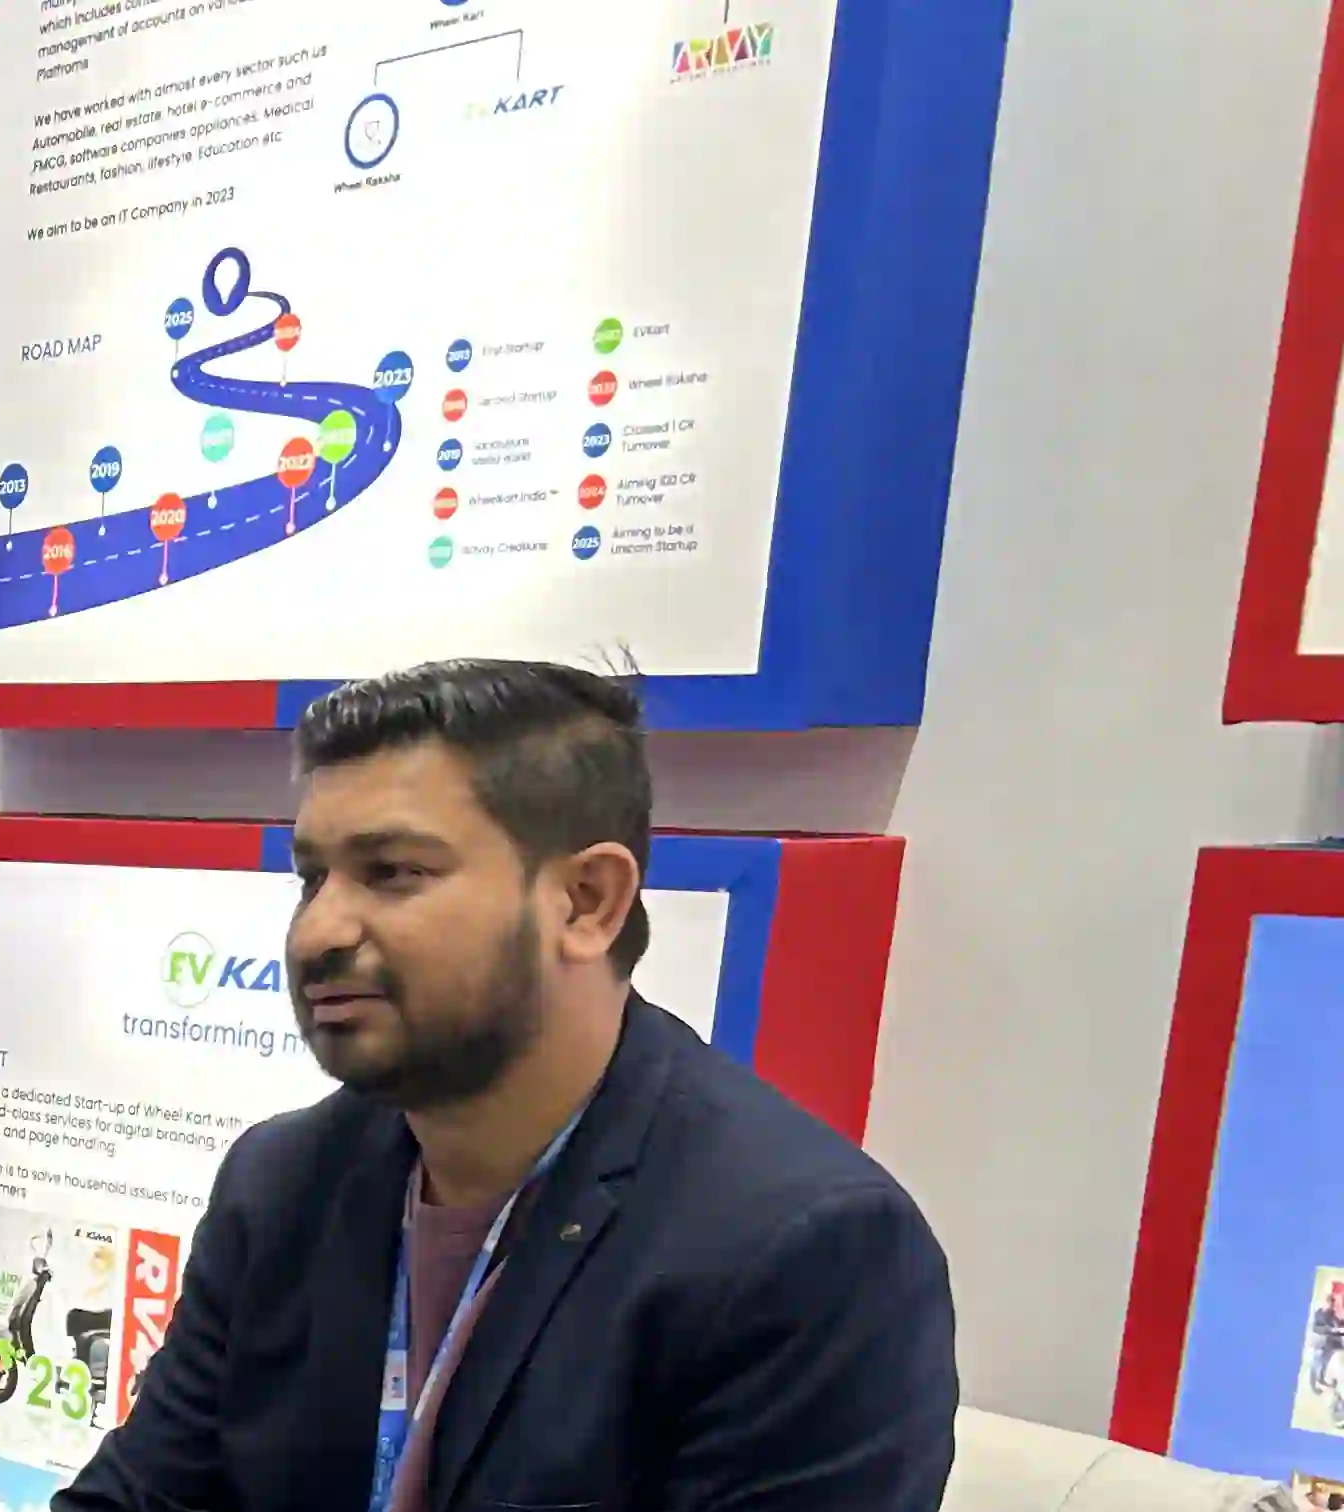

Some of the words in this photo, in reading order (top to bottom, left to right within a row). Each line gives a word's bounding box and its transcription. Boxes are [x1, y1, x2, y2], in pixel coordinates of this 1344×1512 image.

[37, 27, 115, 59] management
[118, 20, 129, 38] of
[131, 6, 187, 34] accounts
[33, 112, 51, 129] We
[53, 105, 81, 122] have
[83, 94, 125, 117] worked
[128, 87, 152, 106] with
[154, 76, 196, 99] almost
[198, 69, 232, 89] every
[277, 48, 309, 70] such
[100, 117, 123, 136] real
[286, 71, 313, 91] and
[70, 143, 118, 166] software
[120, 129, 187, 154] companies
[27, 225, 44, 242] We
[46, 220, 68, 238] aim
[70, 216, 82, 233] to
[84, 214, 99, 231] be
[101, 211, 116, 227] an
[118, 207, 130, 224] IT
[131, 199, 189, 223] Company
[205, 186, 235, 206] 2023
[165, 310, 193, 329] 2025
[20, 339, 63, 362] ROAD
[67, 334, 103, 356] MAP
[373, 366, 413, 387] 2023
[582, 433, 610, 449] 2023
[0, 478, 27, 495] 2013
[90, 460, 120, 480] 2019
[572, 535, 600, 551] 2025
[217, 955, 281, 993] KA
[123, 1011, 275, 1058] transforming
[11, 1086, 72, 1109] dedicated
[74, 1095, 125, 1117] Start-up
[128, 1101, 141, 1118] of
[143, 1104, 183, 1123] Wheel
[185, 1110, 212, 1127] Kart
[215, 1114, 242, 1130] with
[3, 1124, 26, 1140] and
[28, 1129, 60, 1148] page
[44, 1110, 92, 1132] services
[95, 1116, 111, 1133] for
[113, 1119, 153, 1141] digital
[5, 1162, 15, 1177] is
[17, 1164, 29, 1180] to
[64, 1173, 127, 1198] household
[129, 1182, 168, 1204] issues
[171, 1188, 189, 1206] for
